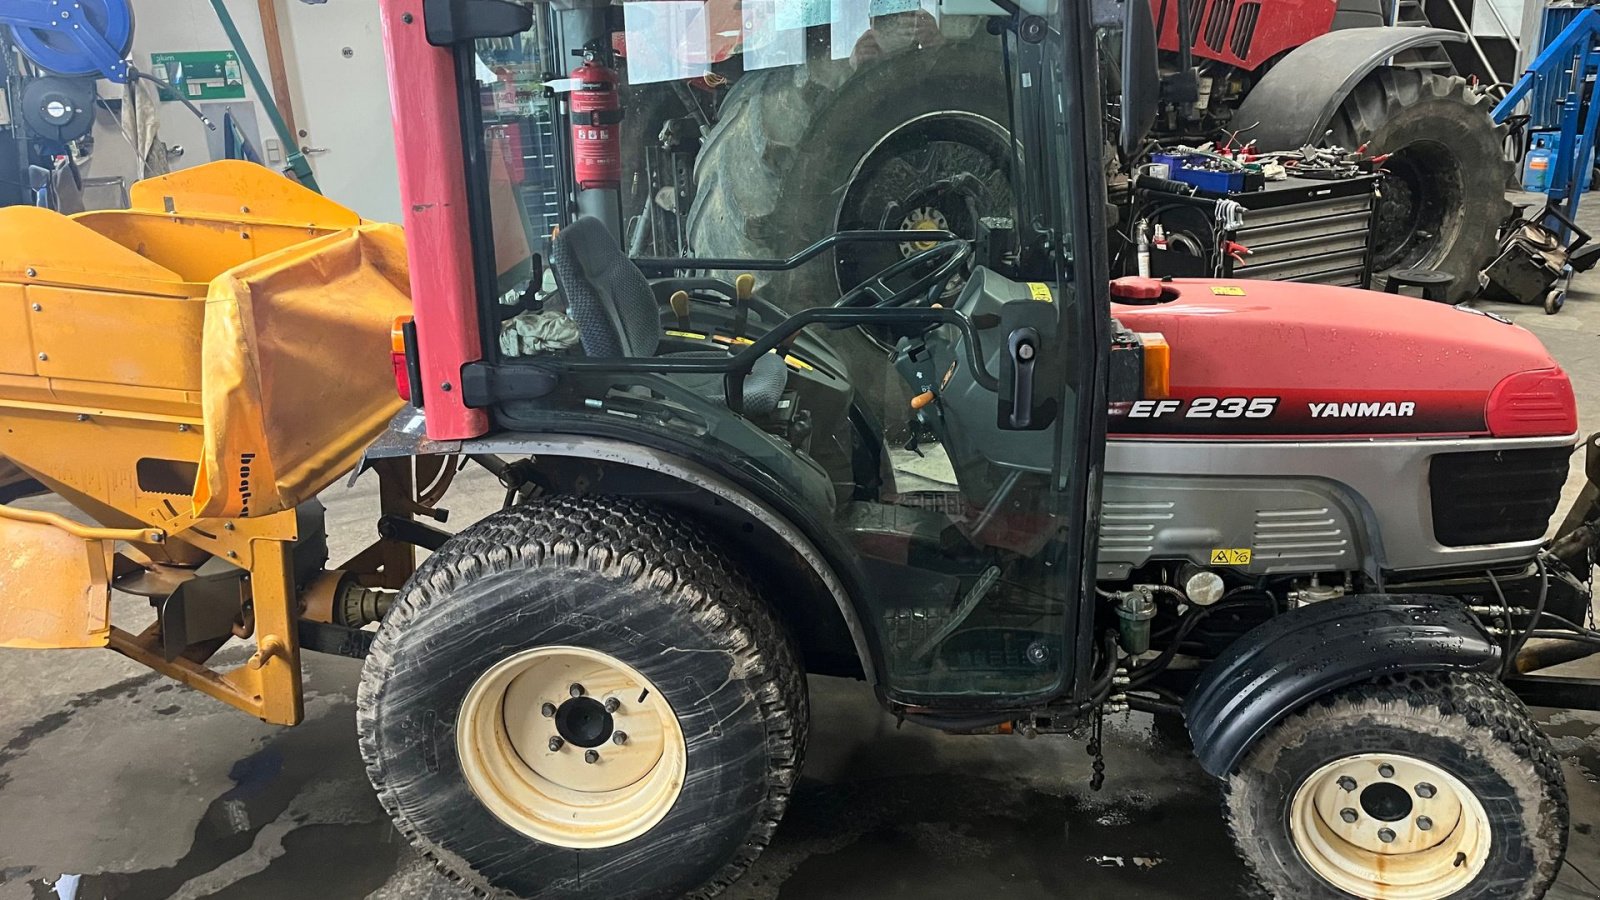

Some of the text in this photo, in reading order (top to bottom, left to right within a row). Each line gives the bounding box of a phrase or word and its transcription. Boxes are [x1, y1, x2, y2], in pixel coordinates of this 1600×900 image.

[1128, 398, 1278, 418] EF 235
[1308, 402, 1416, 417] YANMAR
